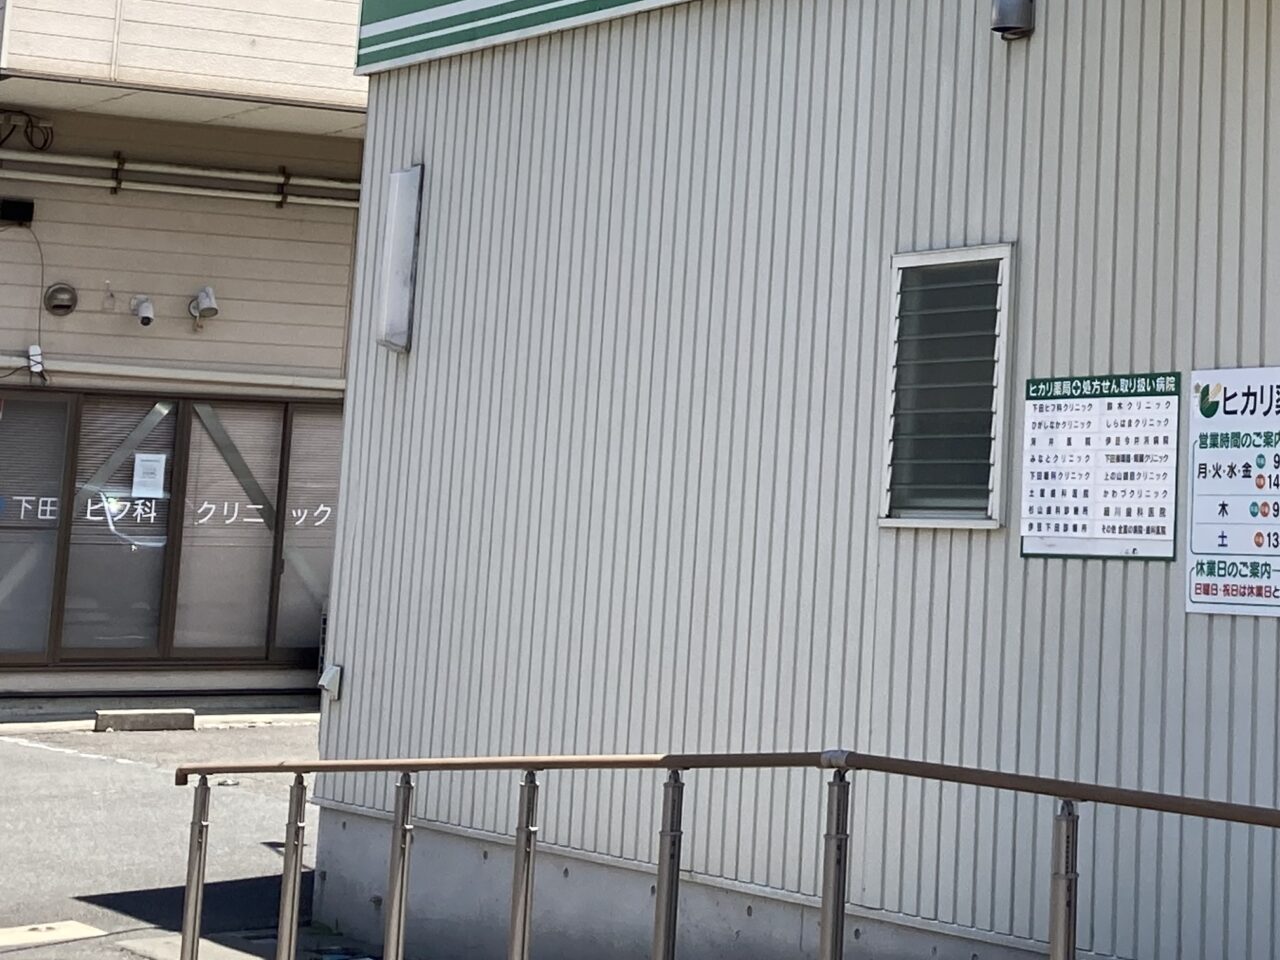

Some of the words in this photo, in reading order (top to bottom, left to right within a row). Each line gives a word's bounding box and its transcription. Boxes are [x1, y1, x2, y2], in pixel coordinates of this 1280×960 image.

[12, 496, 58, 520] 下田
[1218, 501, 1229, 517] 木
[1217, 531, 1228, 547] 土
[1195, 560, 1272, 579] 休業日のご案内
